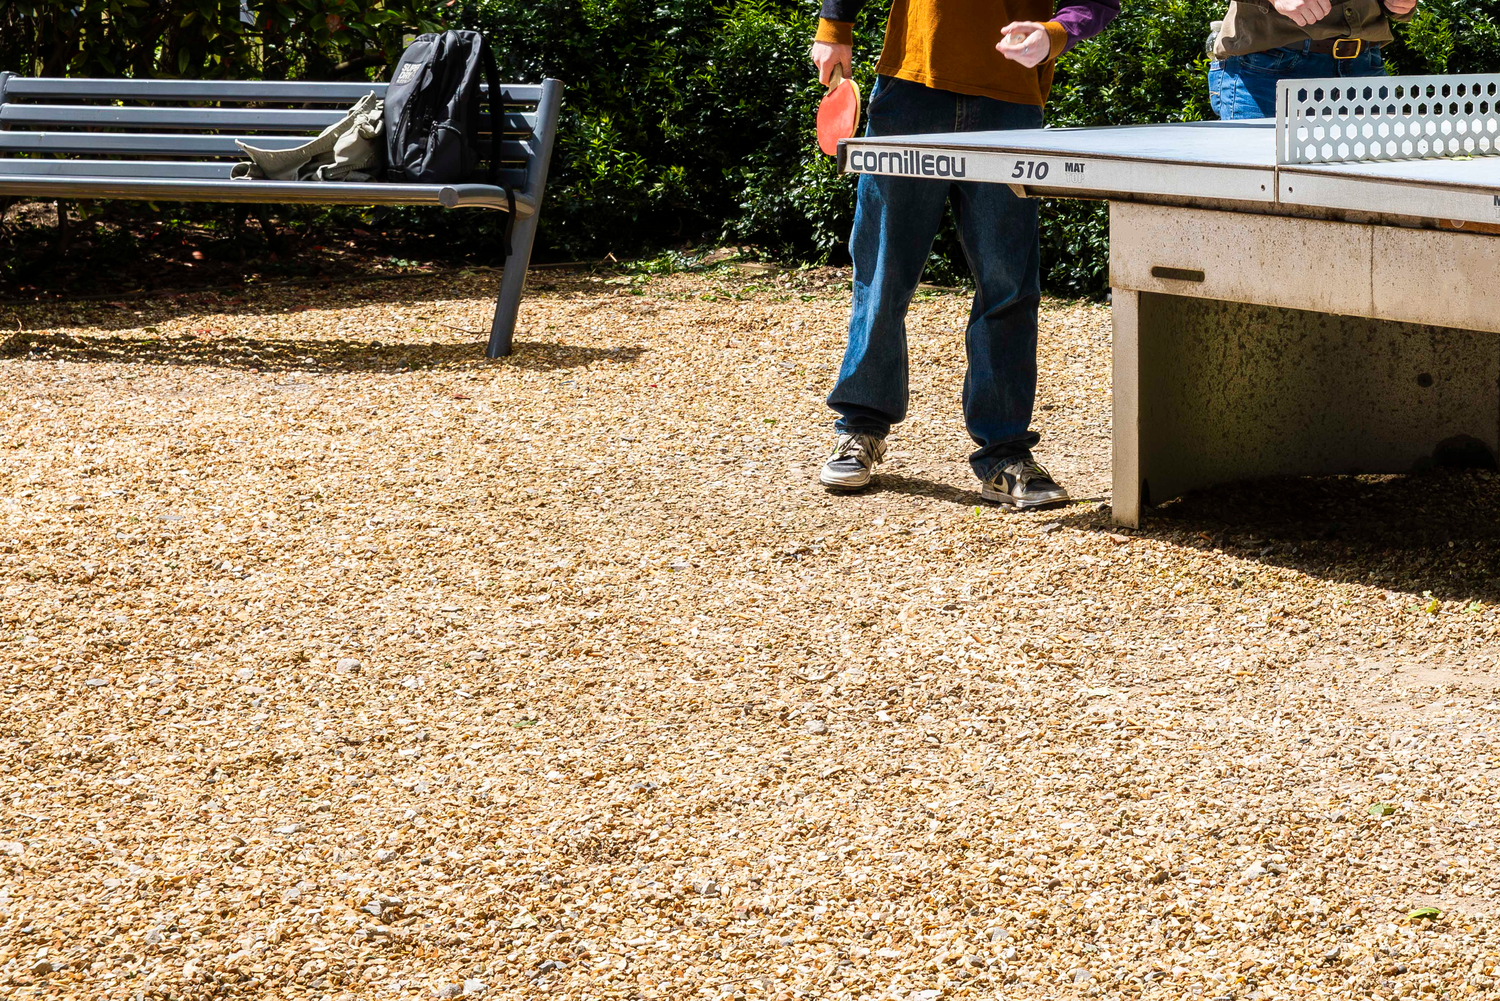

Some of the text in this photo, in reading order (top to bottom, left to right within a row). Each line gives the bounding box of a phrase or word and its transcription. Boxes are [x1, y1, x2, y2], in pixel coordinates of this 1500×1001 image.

[850, 150, 1085, 180] cornilleau 510 MAT
